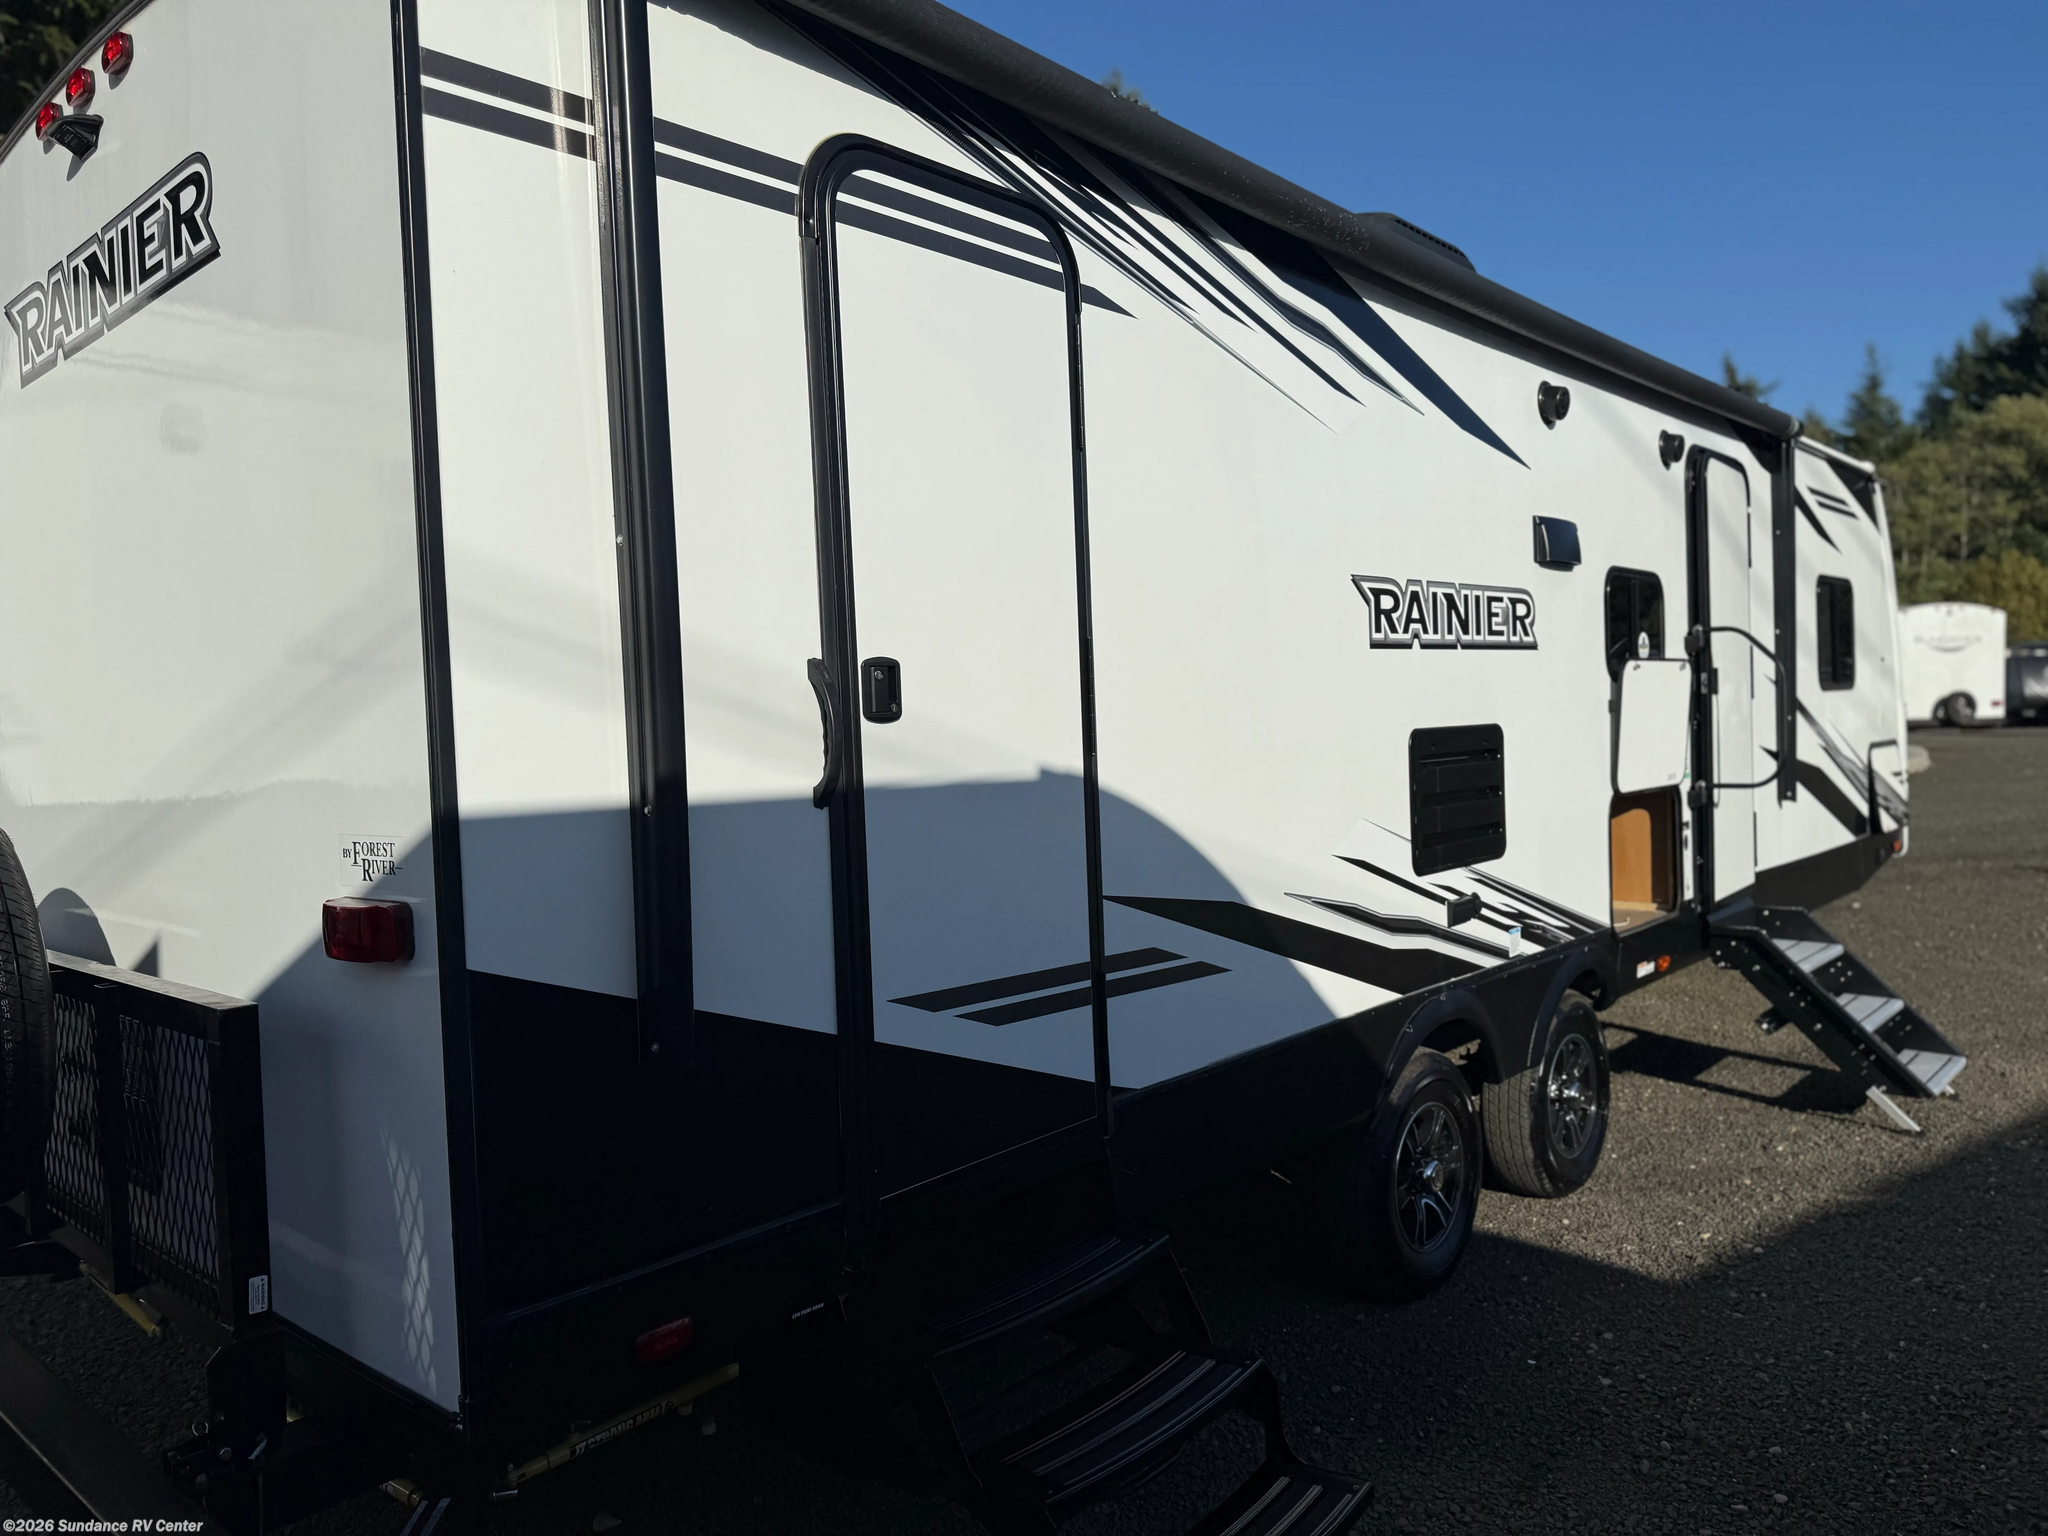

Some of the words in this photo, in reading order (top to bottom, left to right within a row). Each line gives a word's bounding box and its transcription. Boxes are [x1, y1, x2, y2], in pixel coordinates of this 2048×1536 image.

[5, 156, 216, 381] RAINIER
[1354, 577, 1537, 648] RAINIER
[342, 848, 352, 858] BY
[352, 841, 395, 864] FOREST
[361, 858, 396, 882] RIVER
